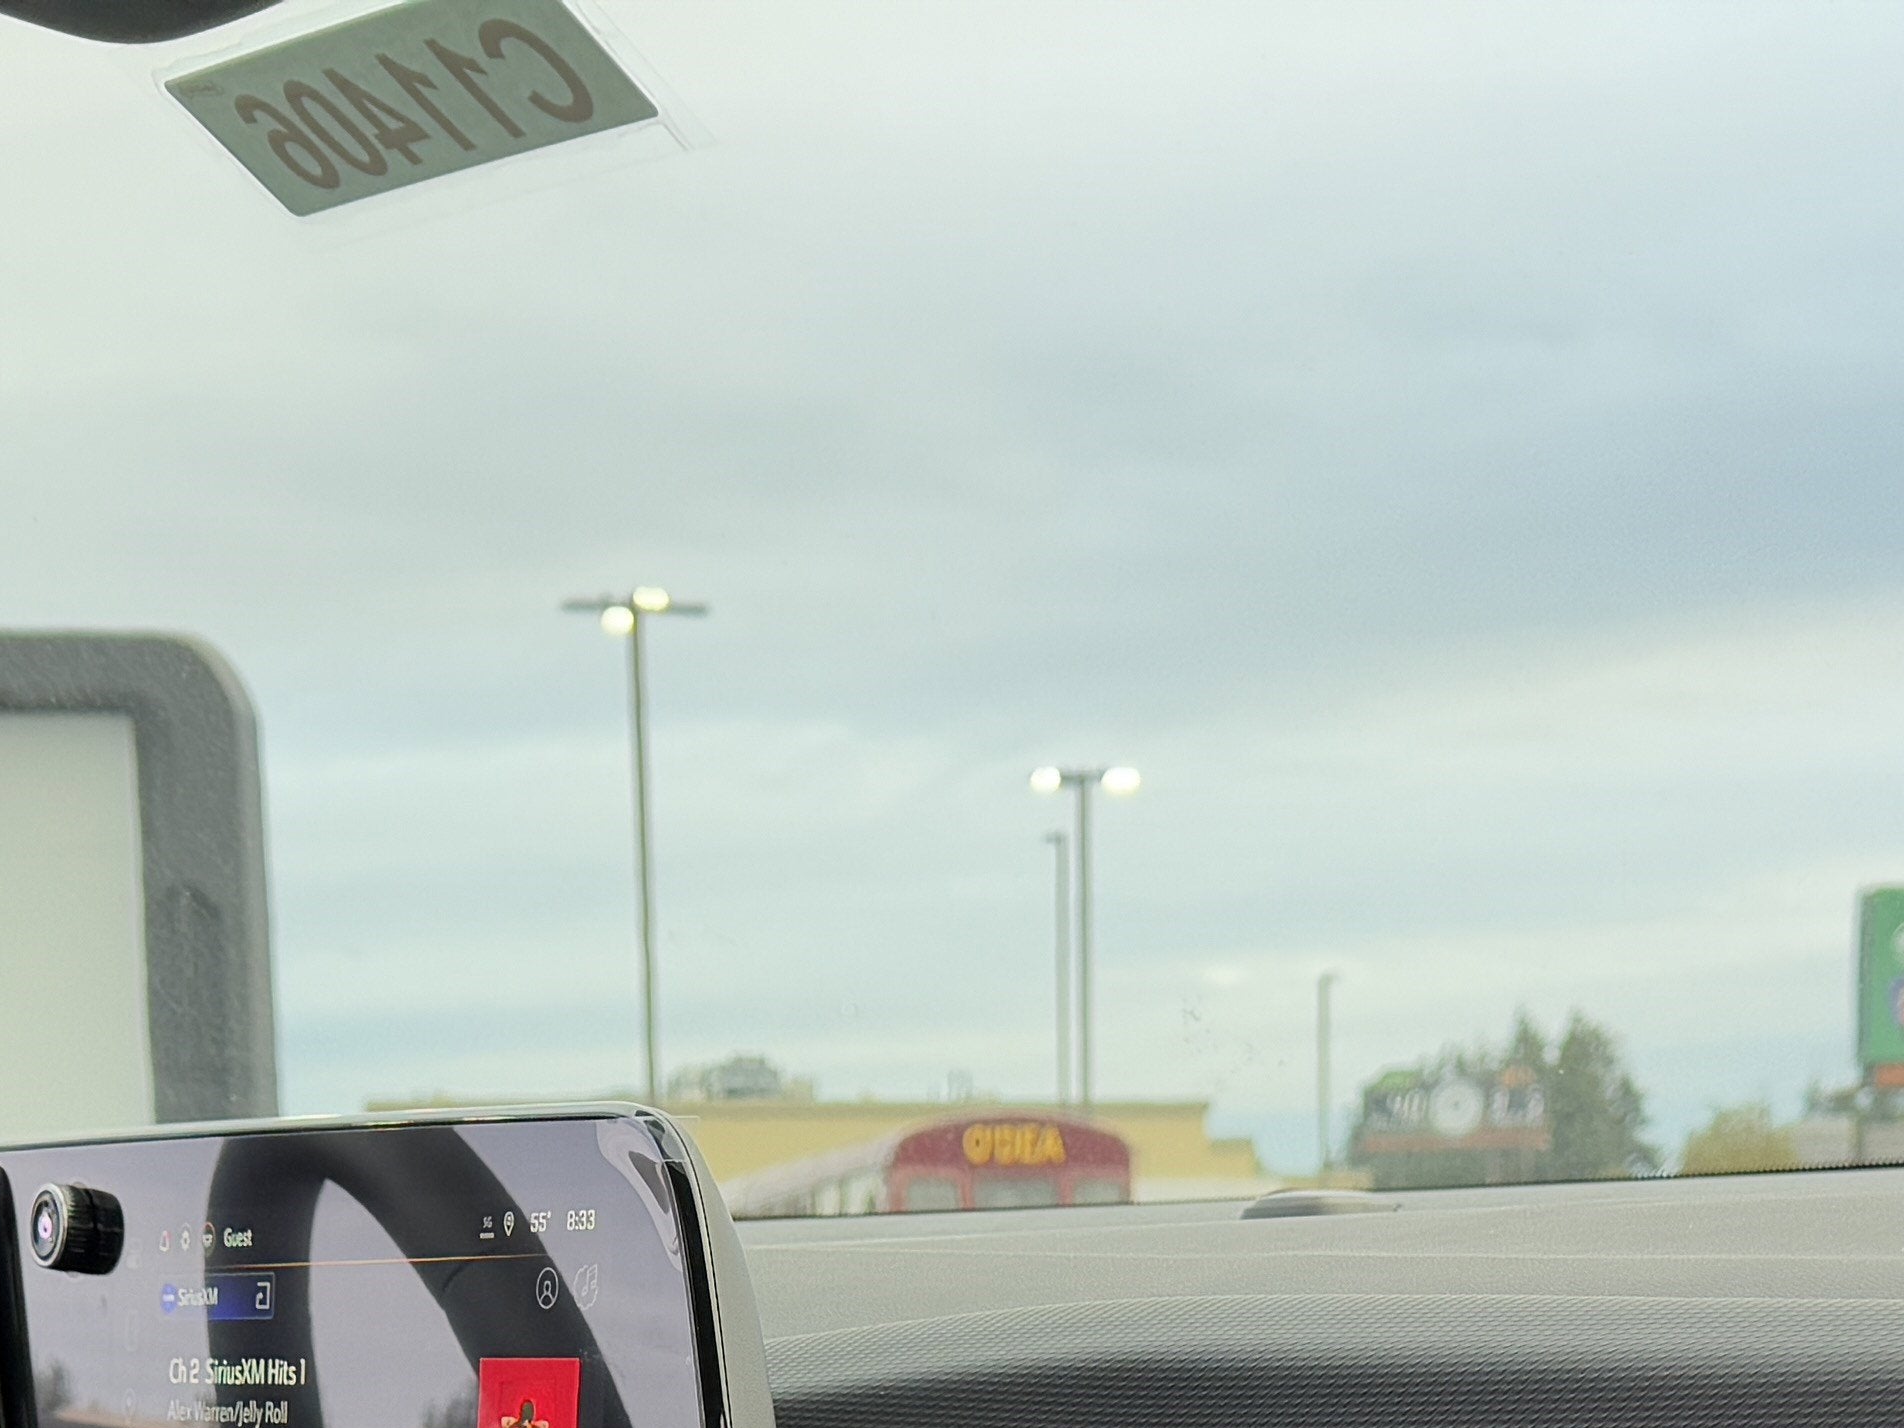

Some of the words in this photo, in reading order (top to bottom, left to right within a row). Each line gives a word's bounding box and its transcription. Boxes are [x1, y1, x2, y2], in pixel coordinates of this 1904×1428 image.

[566, 1208, 596, 1231] 8:33
[223, 1227, 253, 1249] Guest
[178, 1287, 219, 1307] SiriusXM
[169, 1359, 186, 1385] Ch
[189, 1360, 200, 1385] 2
[205, 1357, 265, 1386] SiriusXM
[267, 1358, 297, 1386] Hits
[300, 1358, 307, 1385] 1
[167, 1401, 192, 1422] Alex
[265, 1401, 288, 1425] Roll
